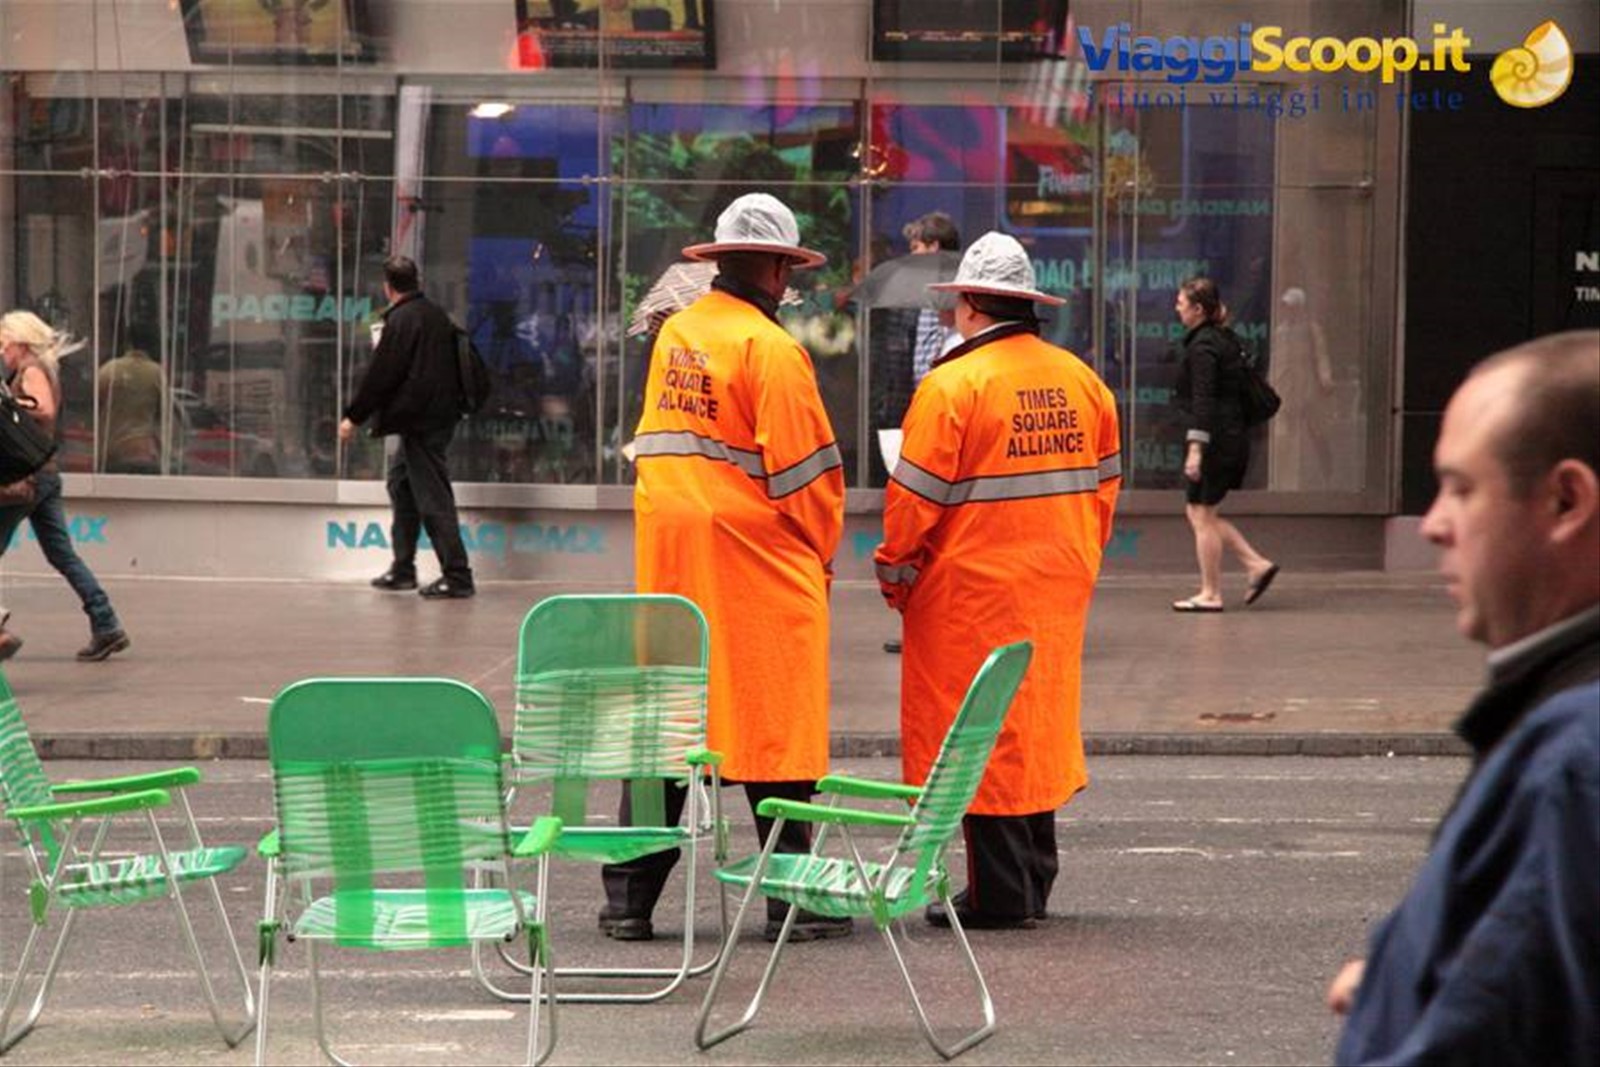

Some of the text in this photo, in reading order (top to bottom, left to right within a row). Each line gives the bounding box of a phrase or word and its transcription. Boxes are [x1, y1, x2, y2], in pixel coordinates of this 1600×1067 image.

[1016, 387, 1068, 411] TIMES
[1012, 409, 1078, 434] SQUARE
[1006, 431, 1085, 459] ALLIANCE
